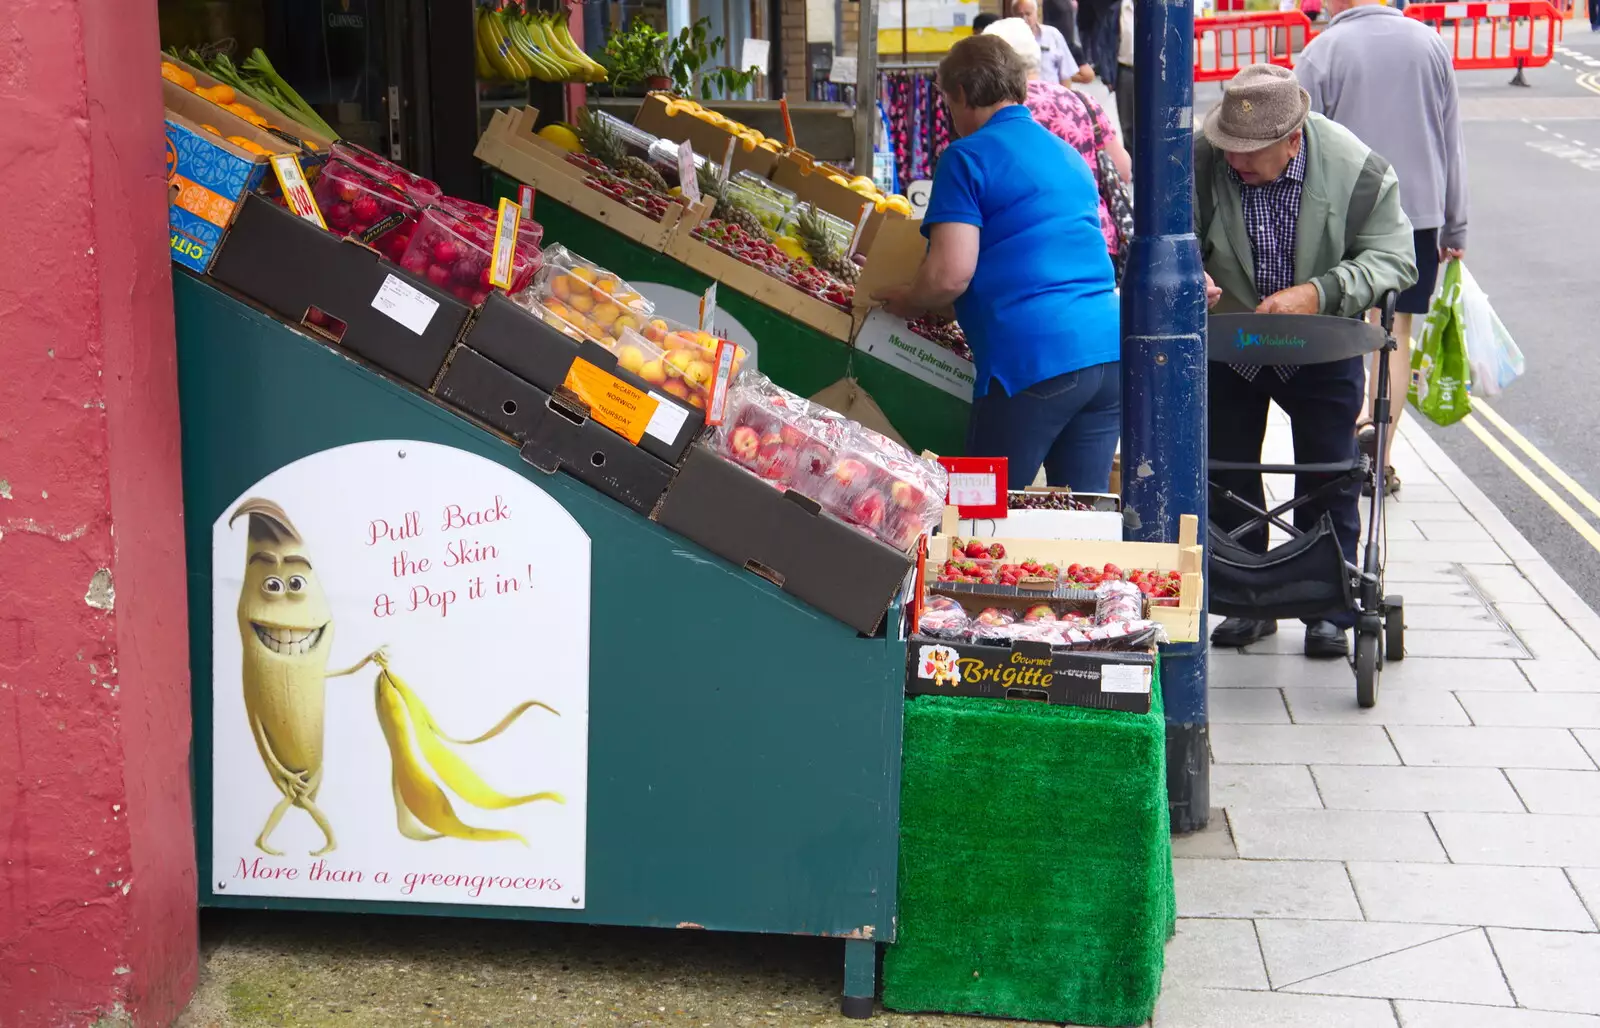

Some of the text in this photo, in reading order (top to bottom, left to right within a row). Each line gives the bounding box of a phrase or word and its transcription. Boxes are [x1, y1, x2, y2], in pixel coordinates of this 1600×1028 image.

[889, 334, 917, 355] Mount
[918, 350, 953, 373] Ephraim
[606, 391, 637, 412] NORWICH
[612, 382, 642, 400] McCARTHY
[598, 404, 632, 426] THURSDAY
[365, 495, 511, 546] Pull Back
[392, 539, 500, 578] the Skin
[406, 584, 457, 618] Pop
[468, 577, 487, 600] it
[955, 656, 1053, 688] Brigitte
[1011, 652, 1053, 667] Gourmet
[232, 857, 563, 897] More than a greengrocers
